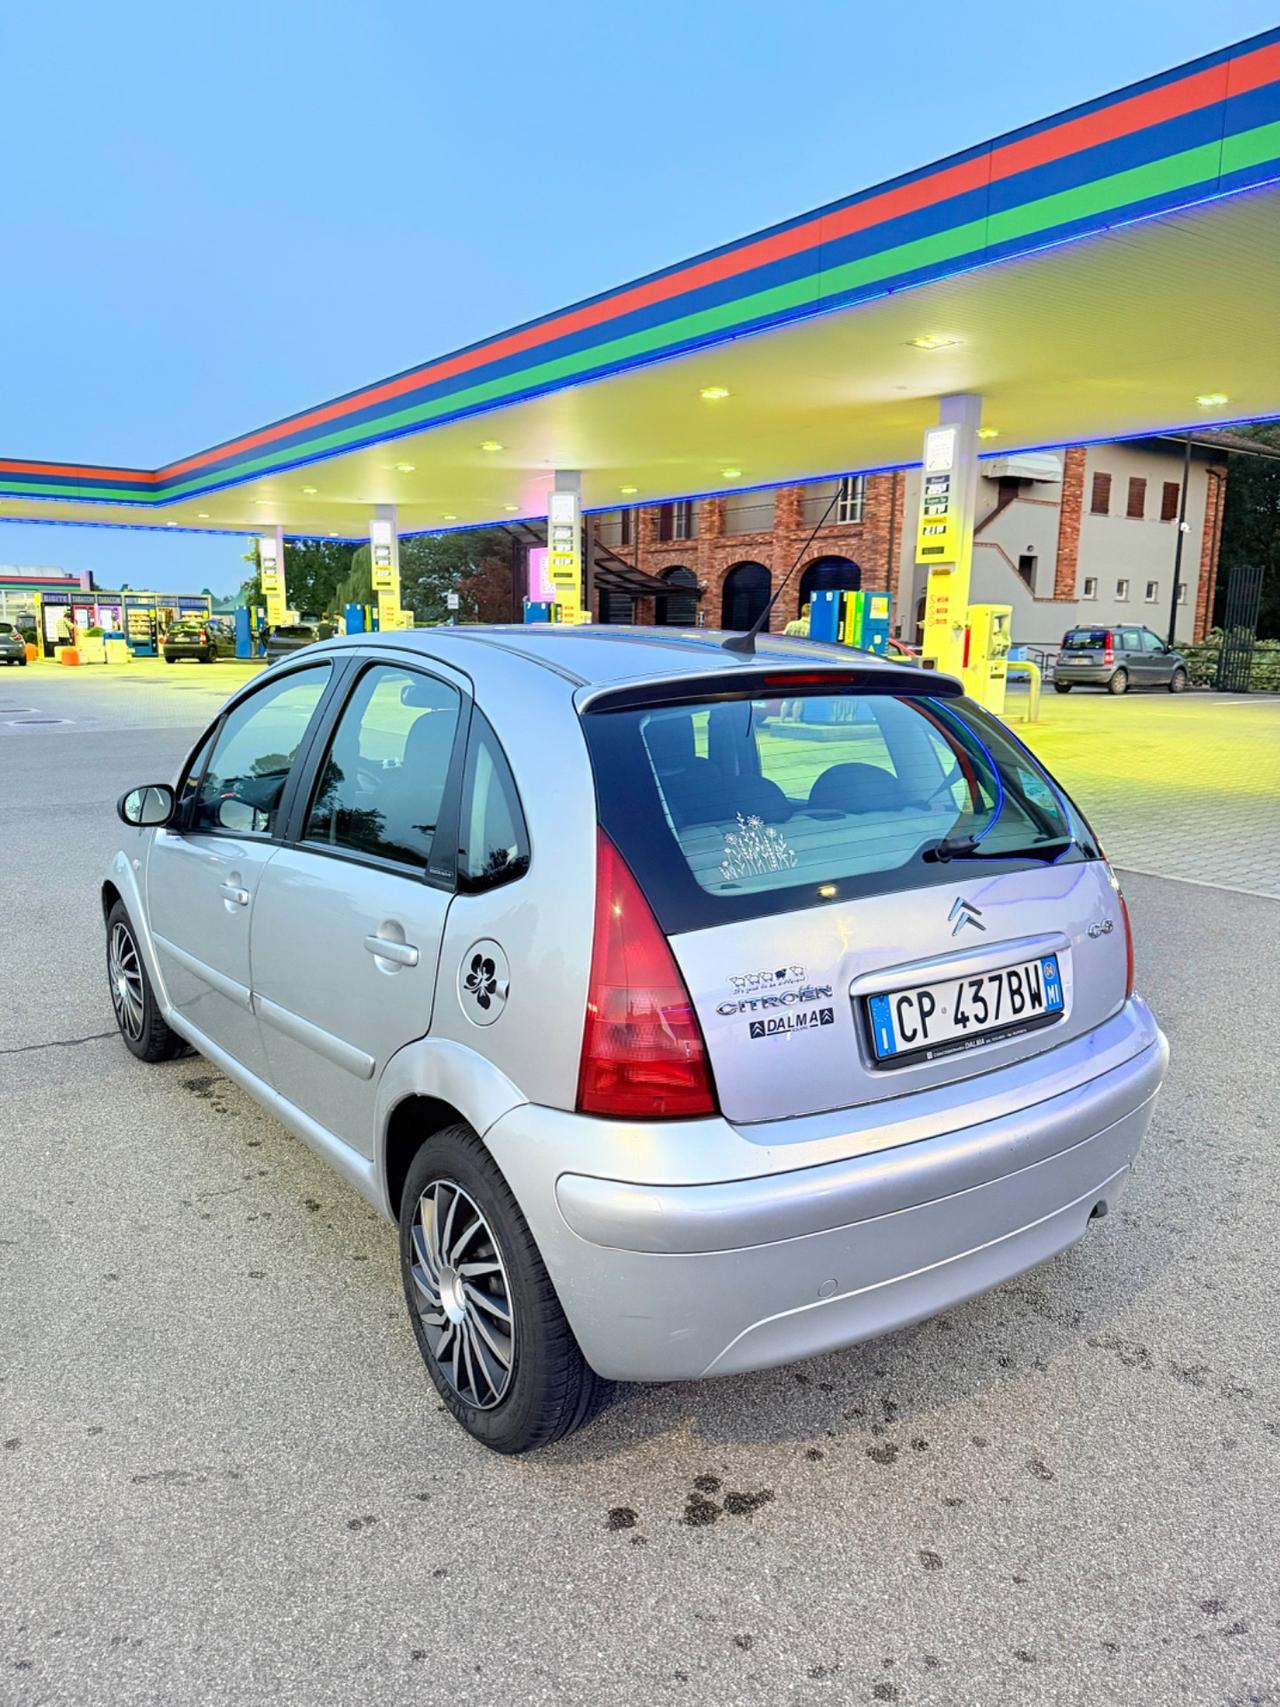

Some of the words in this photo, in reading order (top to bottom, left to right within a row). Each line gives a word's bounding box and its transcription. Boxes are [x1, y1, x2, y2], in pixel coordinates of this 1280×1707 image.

[1047, 983, 1060, 1005] MI
[767, 1010, 819, 1033] DALMA
[896, 990, 936, 1043] CP
